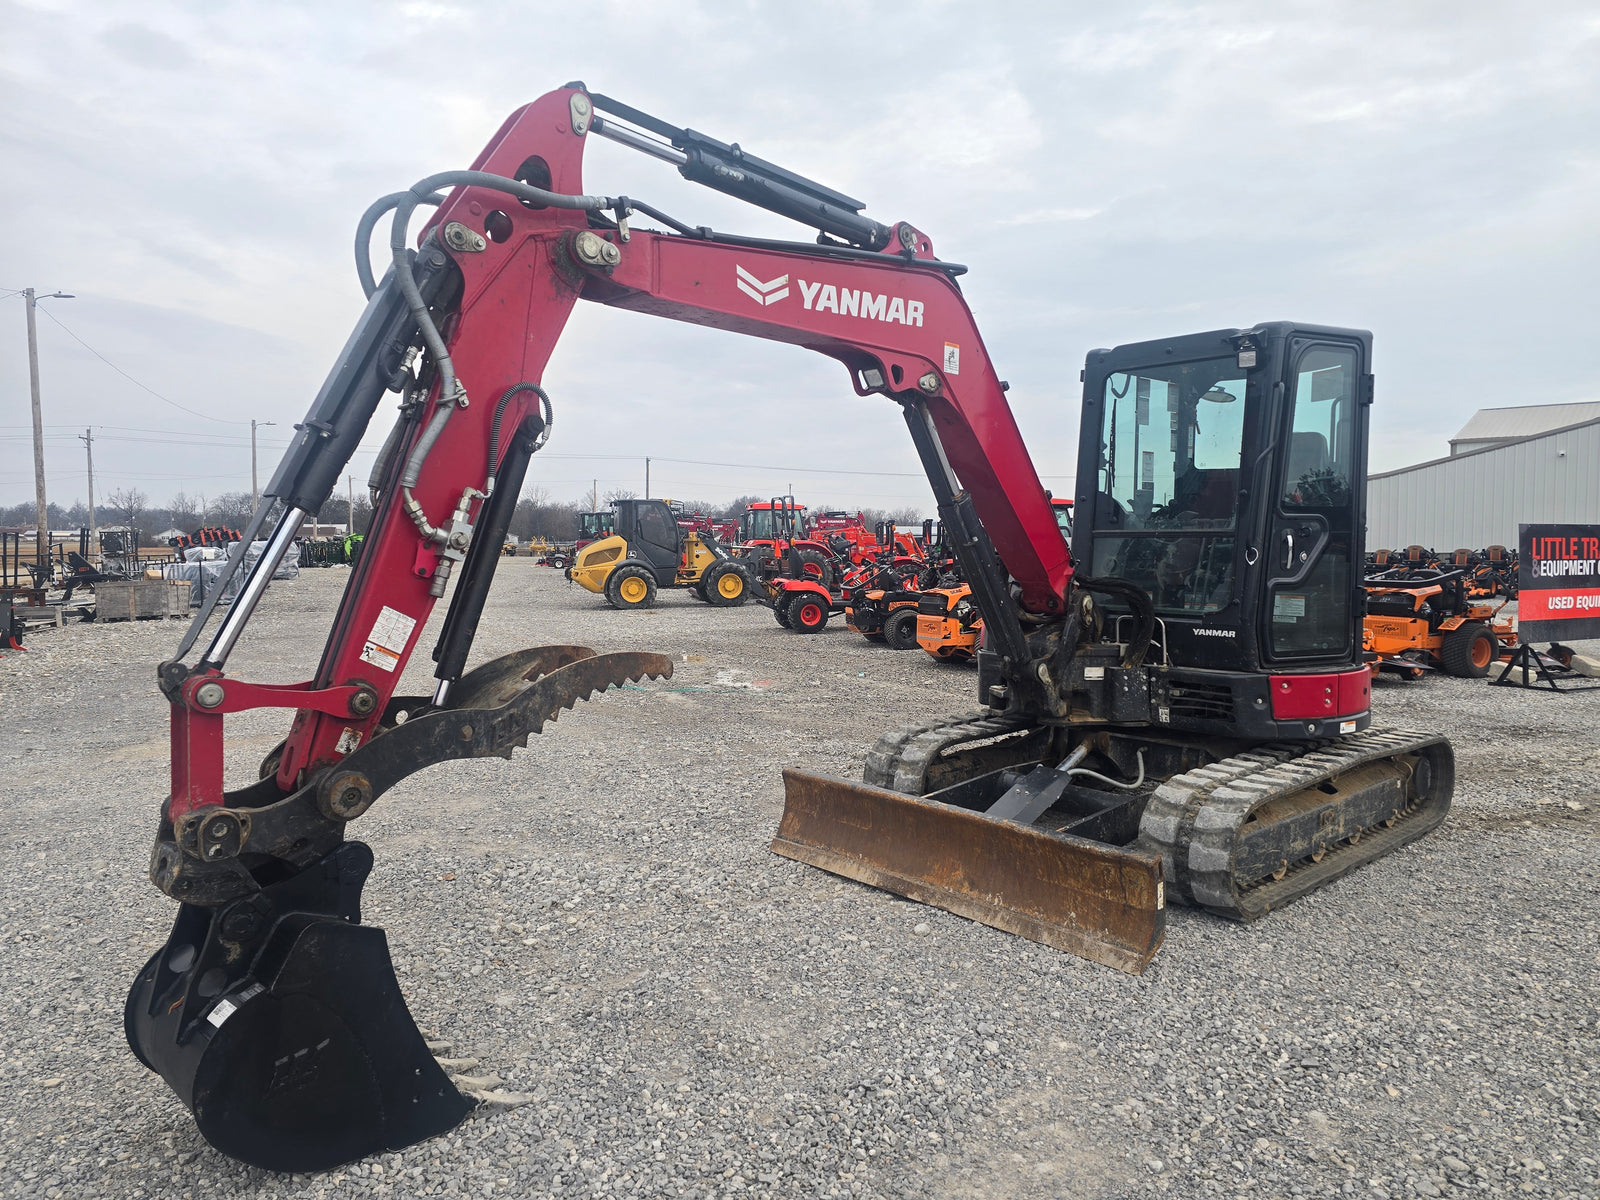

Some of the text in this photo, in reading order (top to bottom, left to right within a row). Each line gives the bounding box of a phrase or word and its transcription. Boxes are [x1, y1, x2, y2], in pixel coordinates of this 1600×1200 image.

[797, 279, 925, 327] YANMAR
[1532, 537, 1600, 560] LITTLE TR
[1548, 595, 1600, 610] USED EQUI
[1192, 628, 1236, 638] YANMAR
